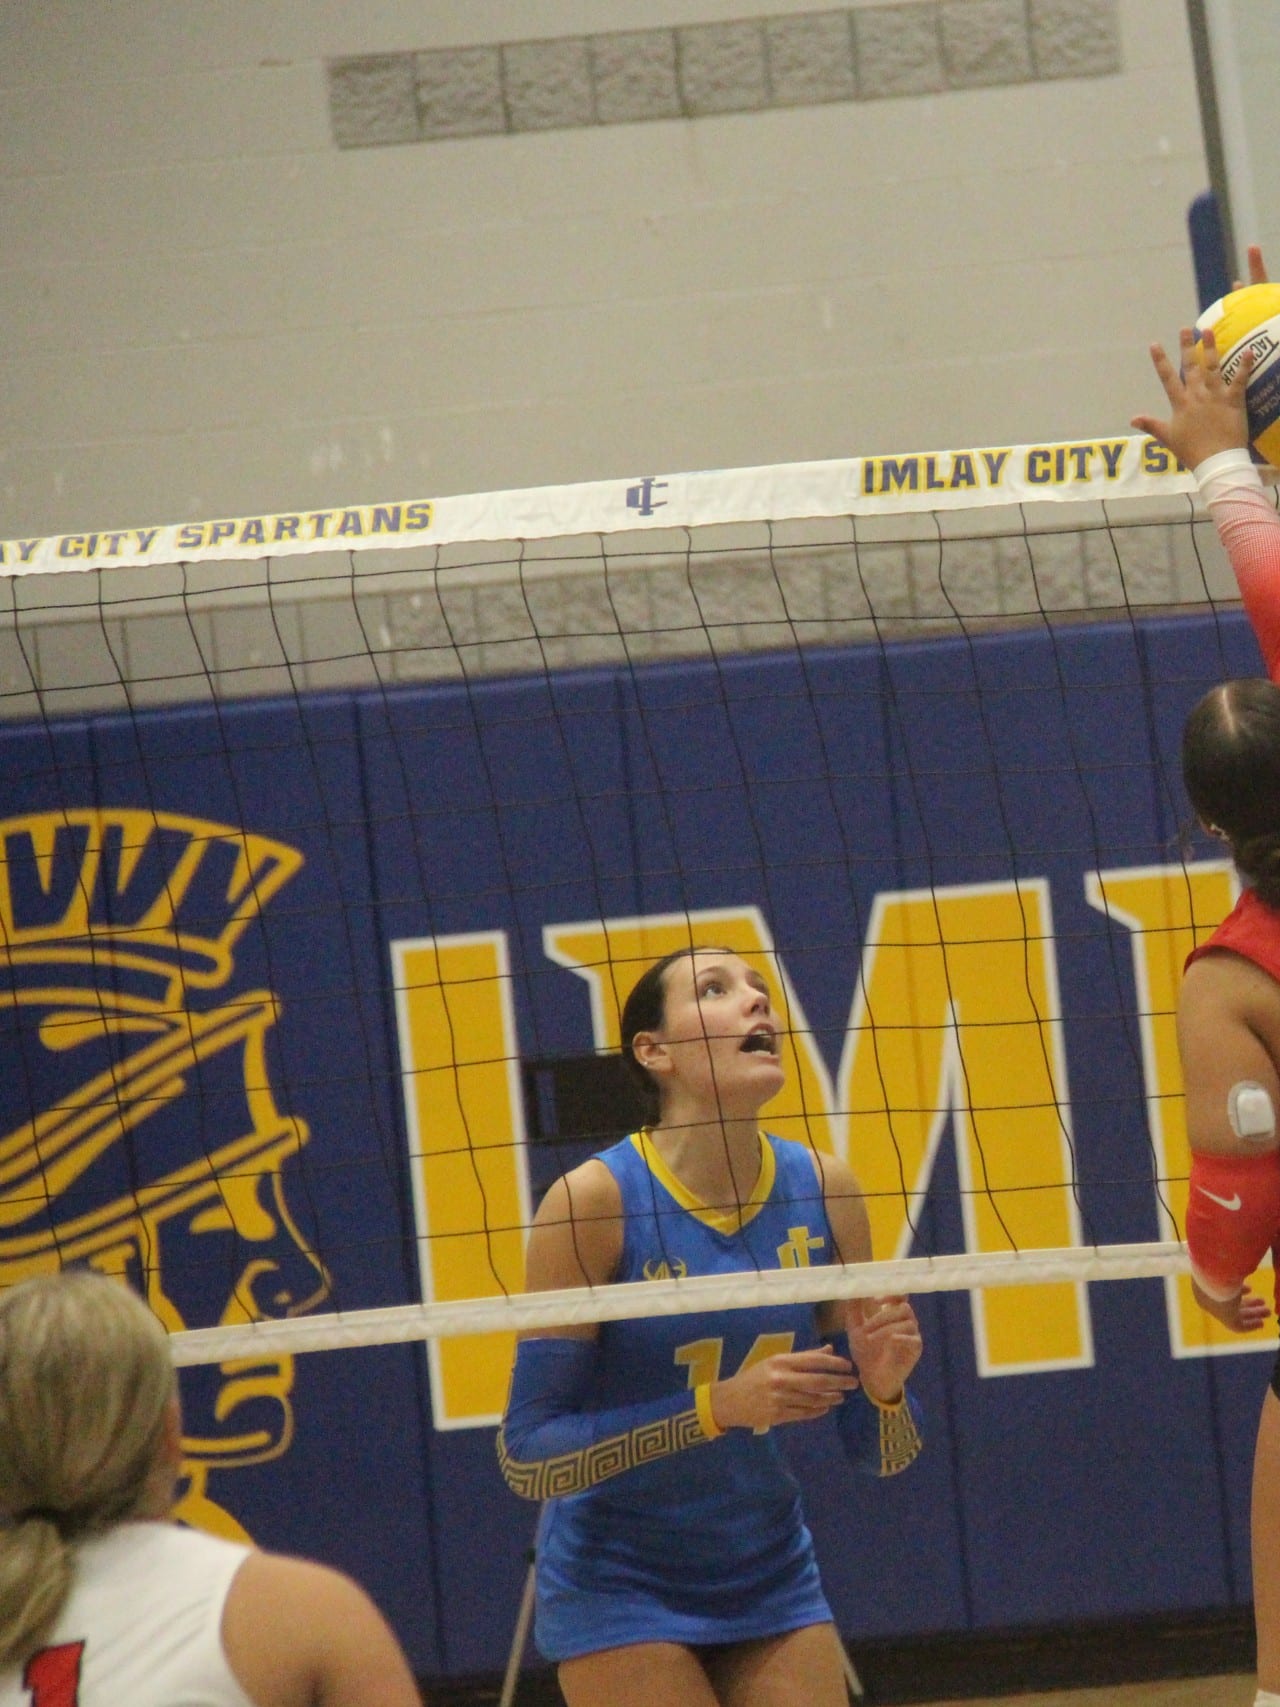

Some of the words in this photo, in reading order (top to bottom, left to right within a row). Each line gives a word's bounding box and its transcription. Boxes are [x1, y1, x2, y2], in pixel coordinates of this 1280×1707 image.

[1220, 335, 1280, 387] TACAR
[862, 450, 1010, 495] IMLAY
[1025, 442, 1127, 485] CITY
[57, 527, 161, 559] CITY
[176, 502, 433, 550] SPARTANS
